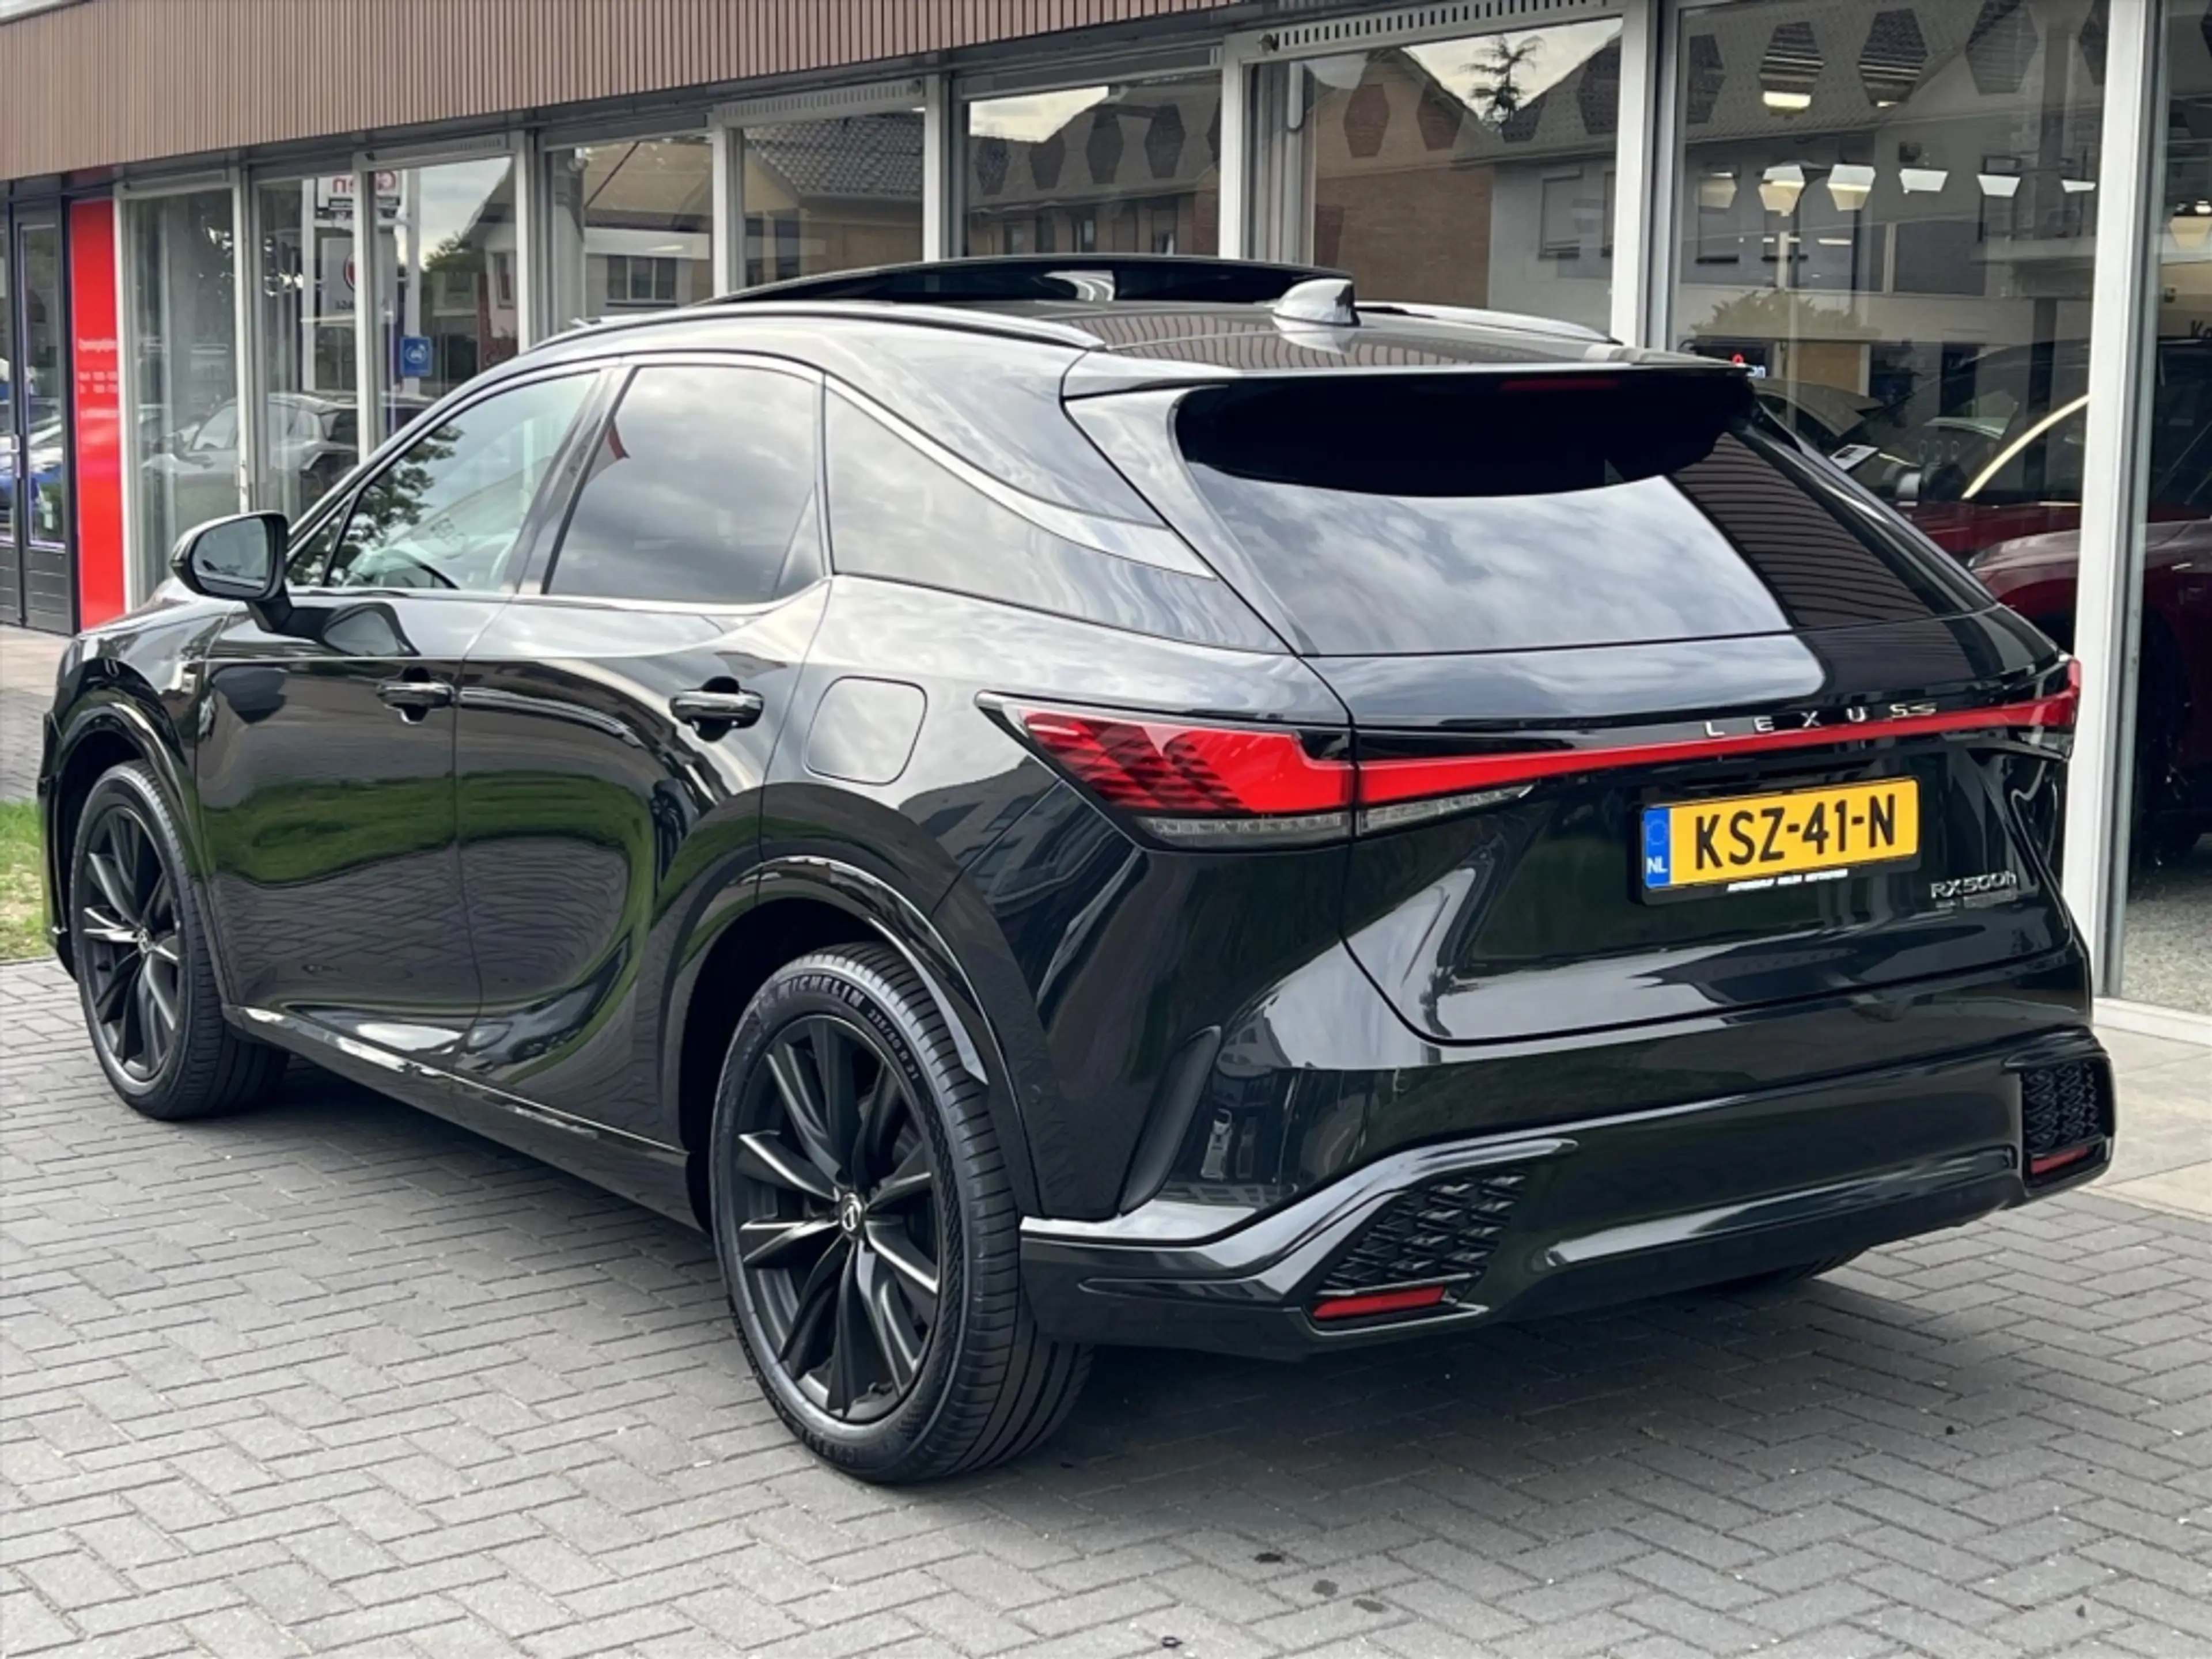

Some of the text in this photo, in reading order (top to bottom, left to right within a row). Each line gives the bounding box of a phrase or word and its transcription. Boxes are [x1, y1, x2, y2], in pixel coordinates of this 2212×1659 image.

[1704, 703, 1918, 737] LEXUS
[1695, 793, 1896, 870] KSZ-41-N
[1646, 855, 1668, 874] NL
[778, 975, 865, 1007] MICHELIN
